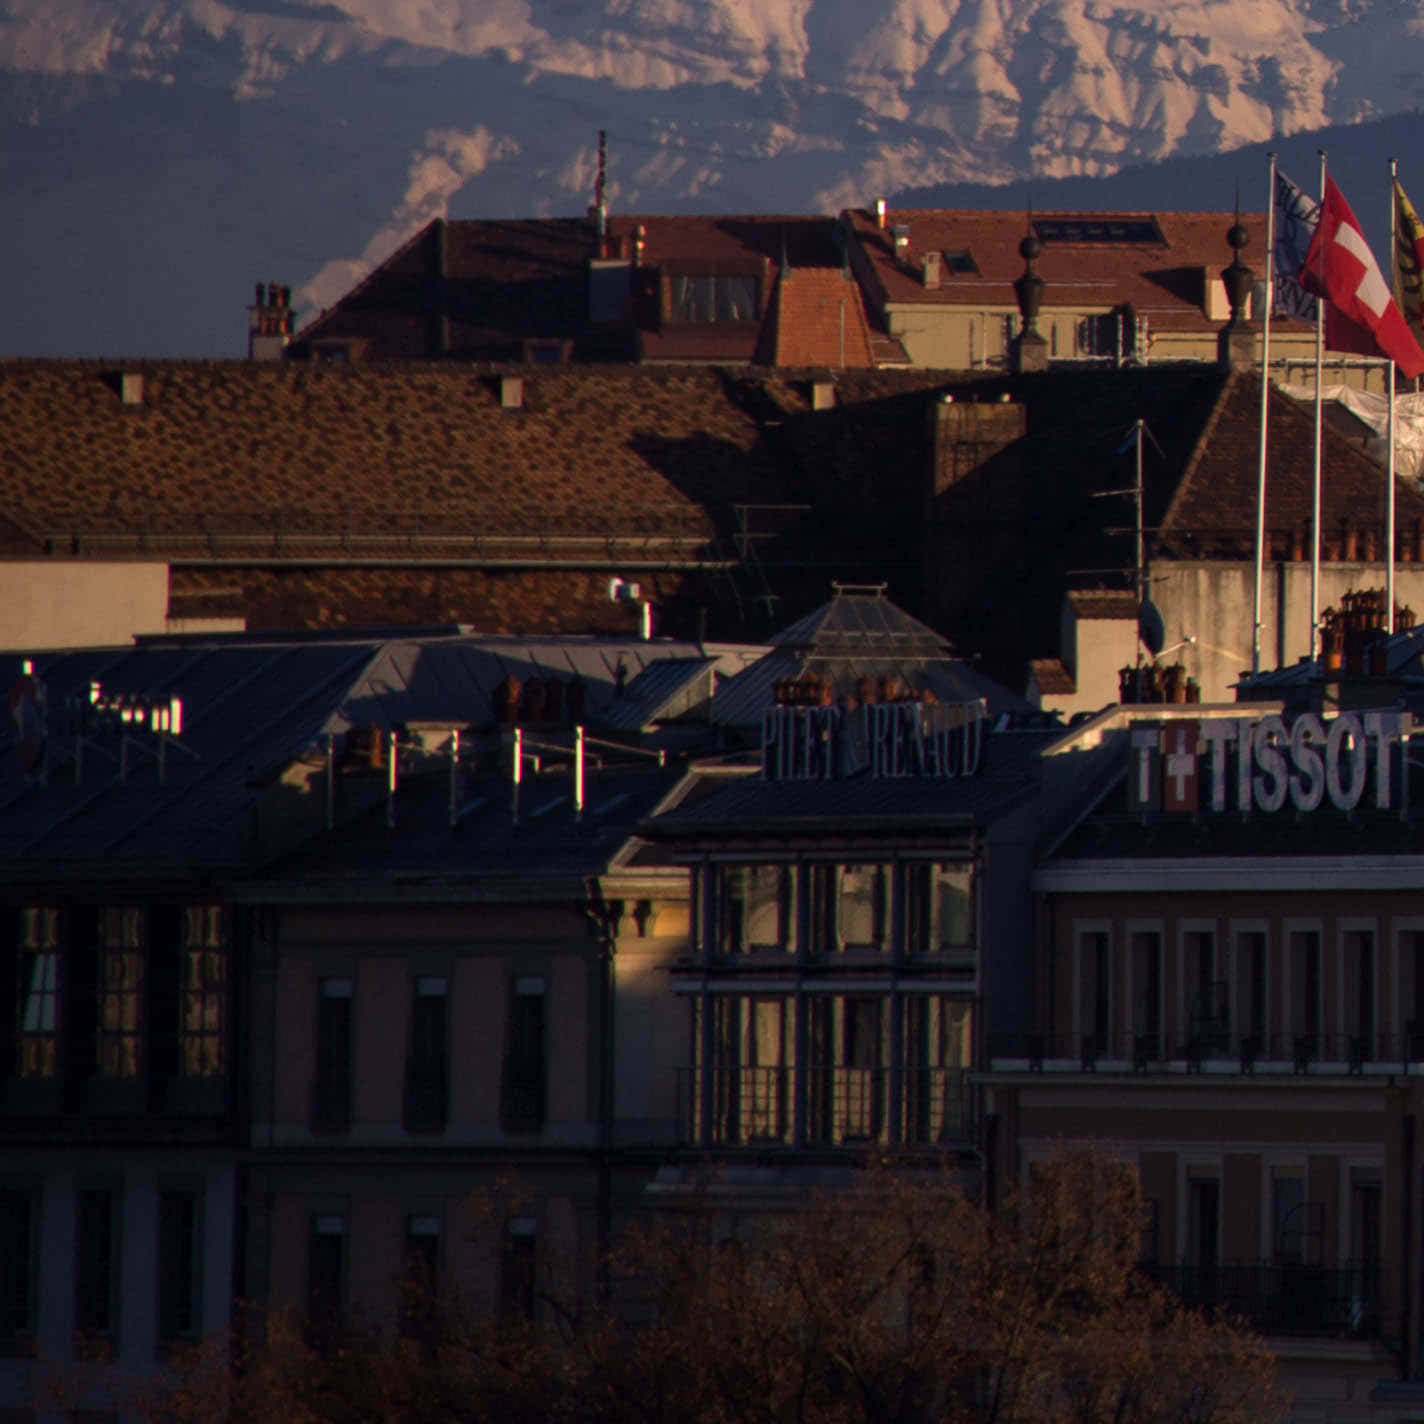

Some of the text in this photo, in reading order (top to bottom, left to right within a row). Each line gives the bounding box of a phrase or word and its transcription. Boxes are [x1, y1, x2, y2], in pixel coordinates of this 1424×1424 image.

[760, 703, 840, 780] PILET
[870, 698, 986, 781] RENAUD
[1199, 712, 1405, 812] TISSOT
